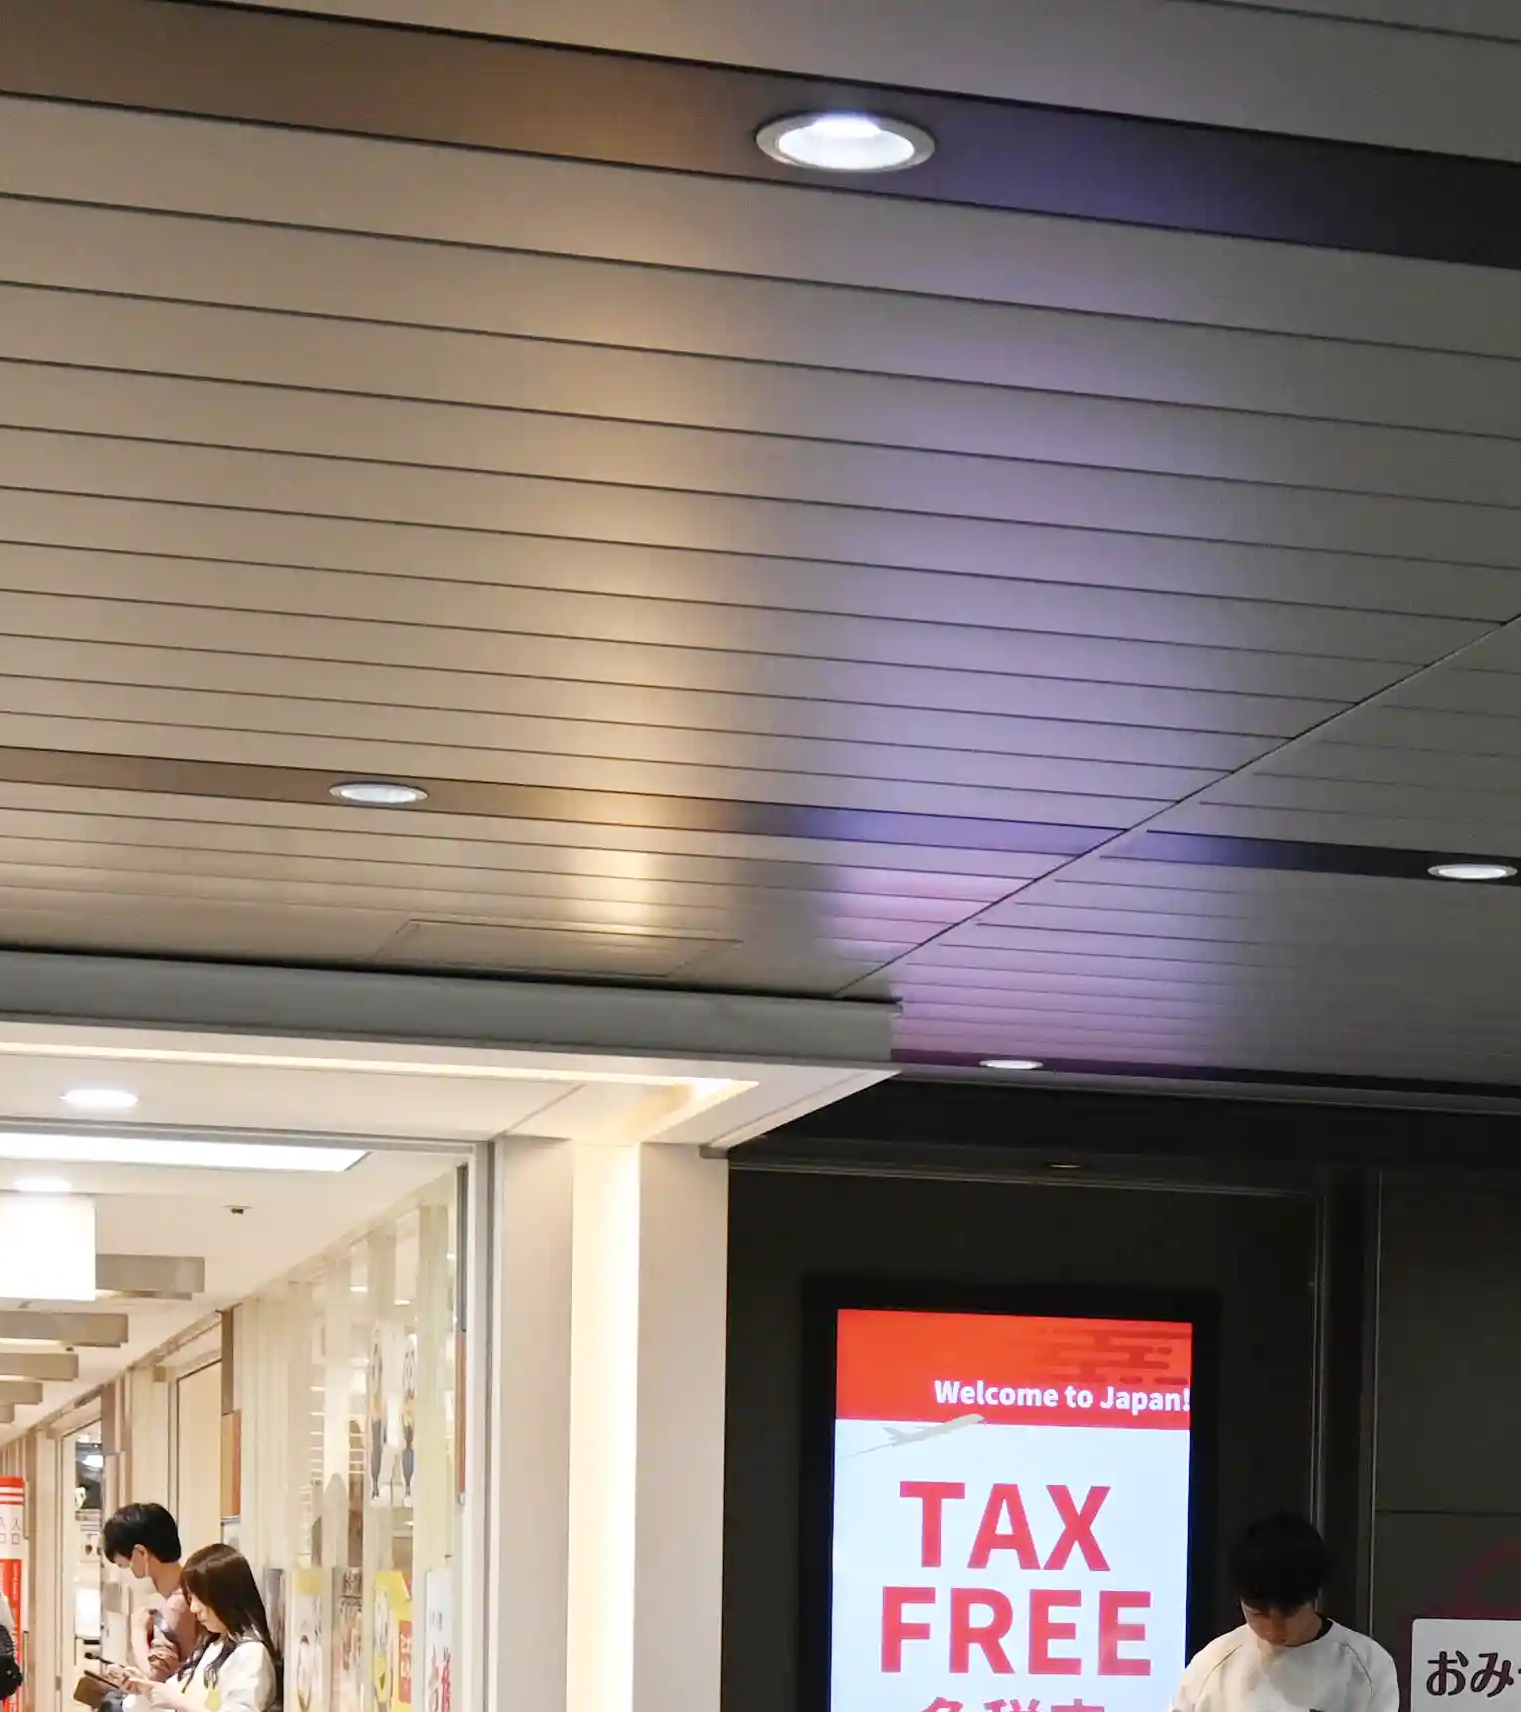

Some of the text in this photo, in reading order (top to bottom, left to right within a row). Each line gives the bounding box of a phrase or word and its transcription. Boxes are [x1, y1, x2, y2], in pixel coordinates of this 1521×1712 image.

[933, 1379, 1191, 1414] Welcome to Japan!
[899, 1480, 1111, 1572] TAX
[880, 1585, 1152, 1676] FREE
